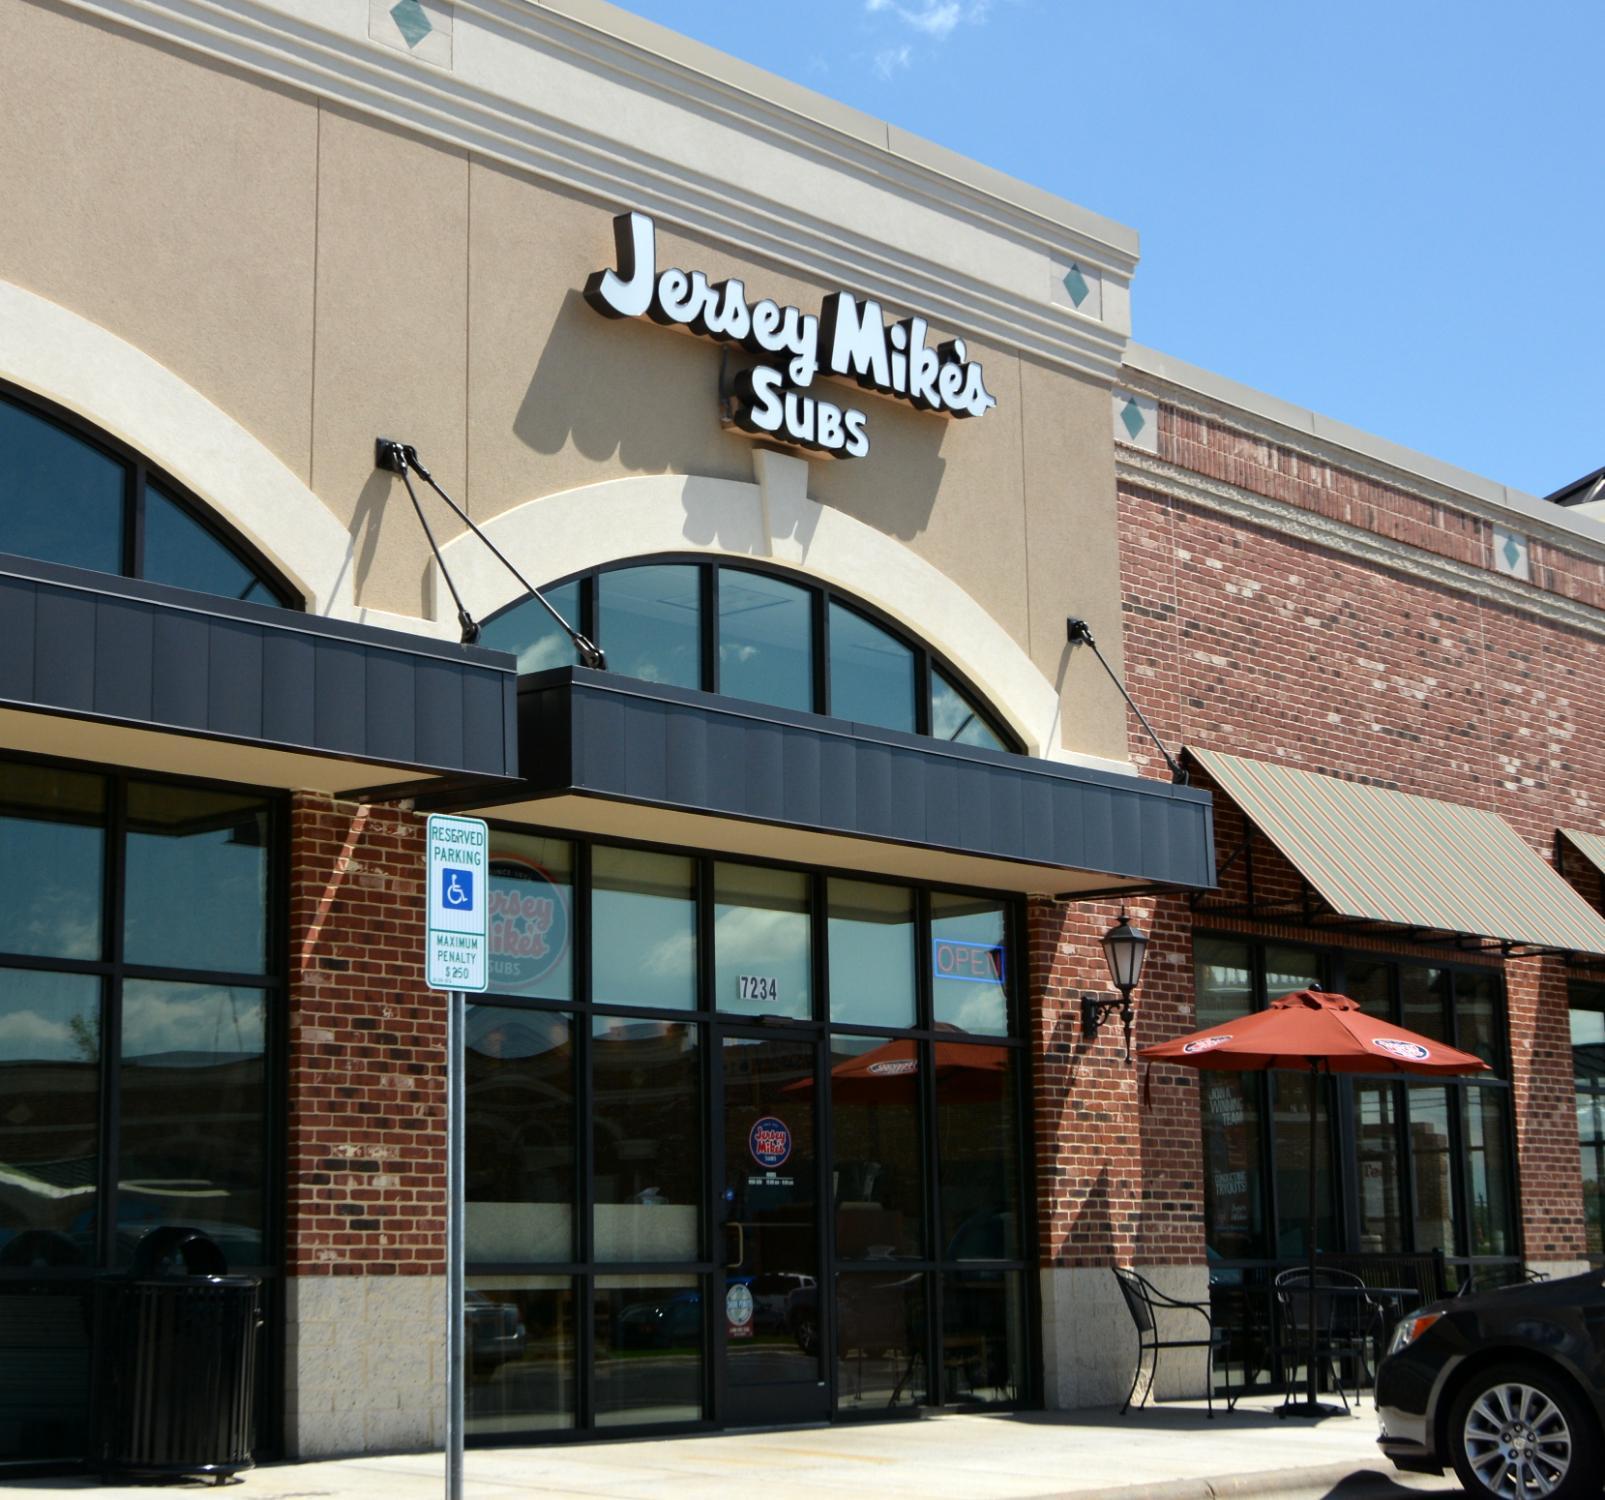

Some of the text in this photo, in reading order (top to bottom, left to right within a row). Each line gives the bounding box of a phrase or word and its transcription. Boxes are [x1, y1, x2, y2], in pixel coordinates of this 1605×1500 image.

[592, 211, 998, 418] Jersey Mike's
[746, 365, 871, 459] SUBS
[432, 826, 484, 847] RESERVED
[434, 847, 482, 866] PARKING
[488, 890, 553, 932] rsey
[437, 936, 478, 948] MAXIMUM
[488, 917, 551, 959] ike's
[437, 950, 477, 965] PENALTY
[937, 945, 1001, 976] OPEN
[740, 976, 777, 1000] 7234
[755, 1126, 786, 1145] Jersey
